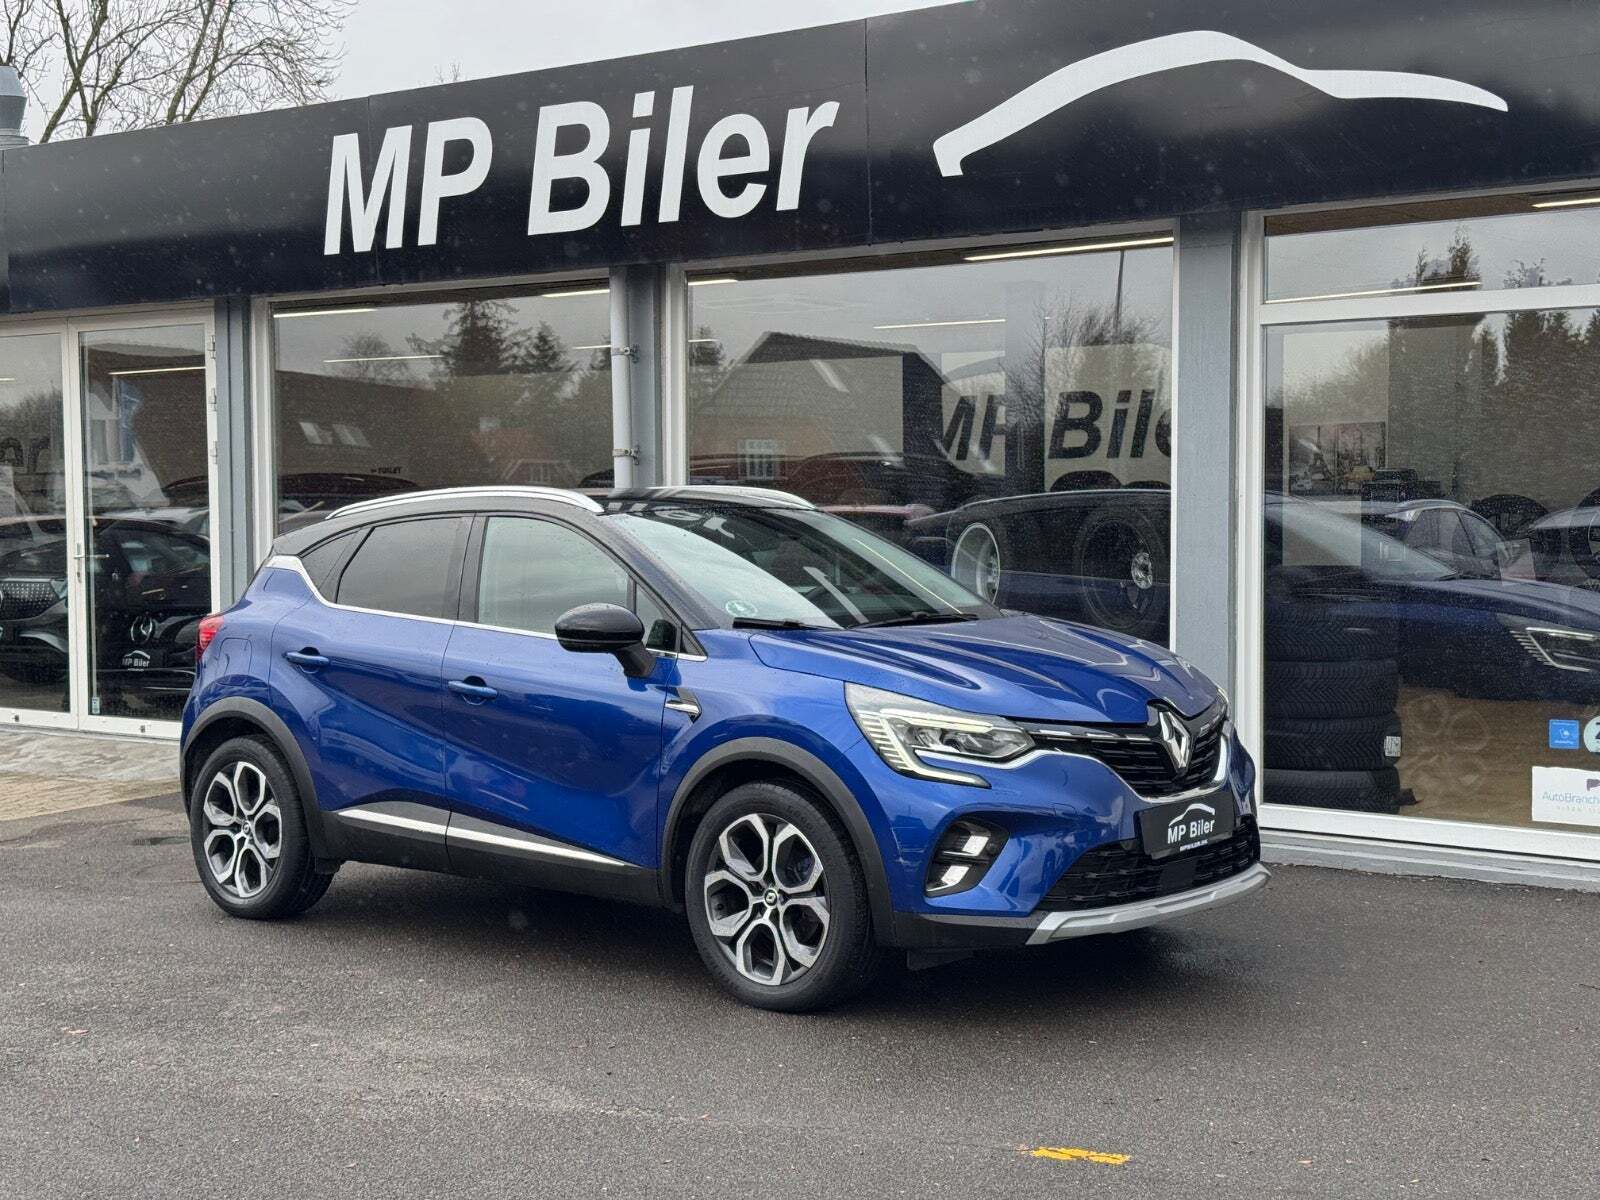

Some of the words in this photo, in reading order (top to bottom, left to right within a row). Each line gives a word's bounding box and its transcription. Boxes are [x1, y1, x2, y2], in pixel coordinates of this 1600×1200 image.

[323, 116, 493, 256] MP
[527, 85, 840, 236] Biler
[1167, 824, 1187, 844] MP
[1189, 819, 1216, 838] Biler
